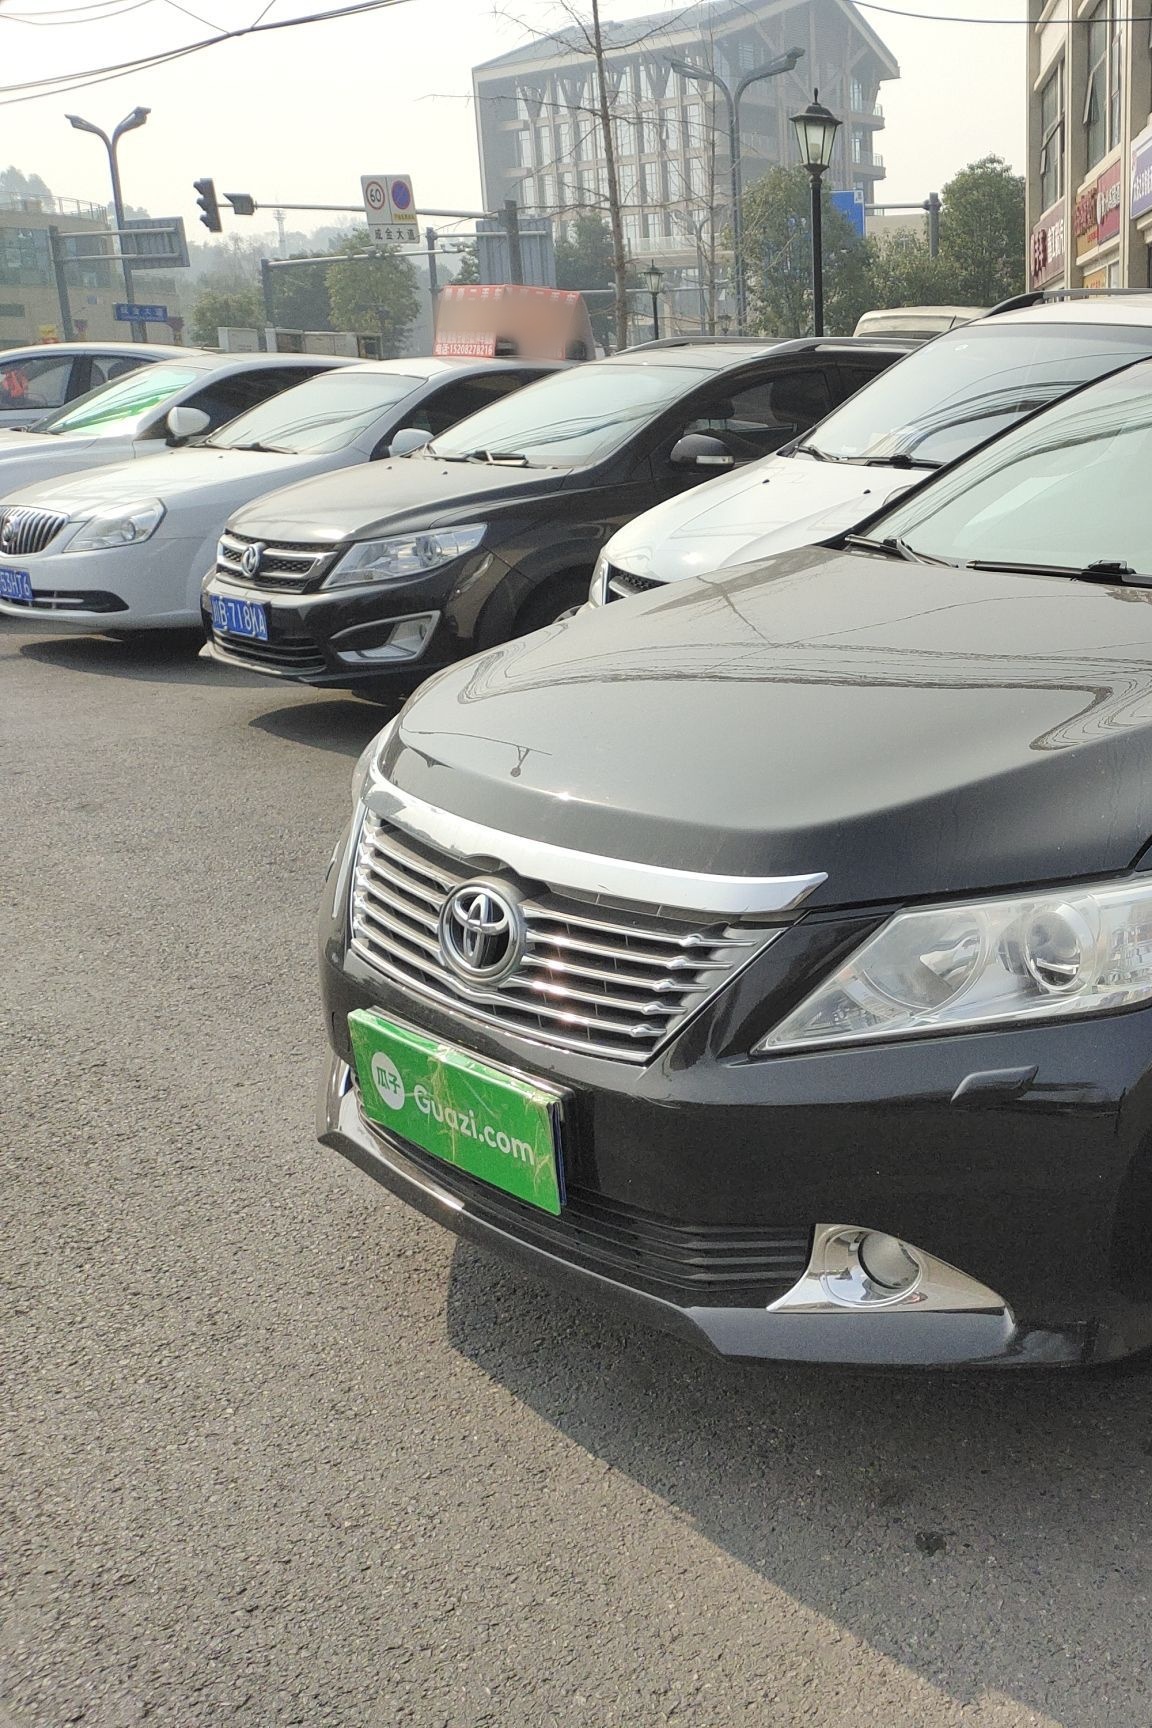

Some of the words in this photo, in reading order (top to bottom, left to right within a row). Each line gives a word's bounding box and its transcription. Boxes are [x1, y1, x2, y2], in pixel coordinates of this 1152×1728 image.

[369, 188, 382, 203] 60
[376, 1066, 401, 1095] 瓜子
[413, 1083, 535, 1166] Guazi.com
